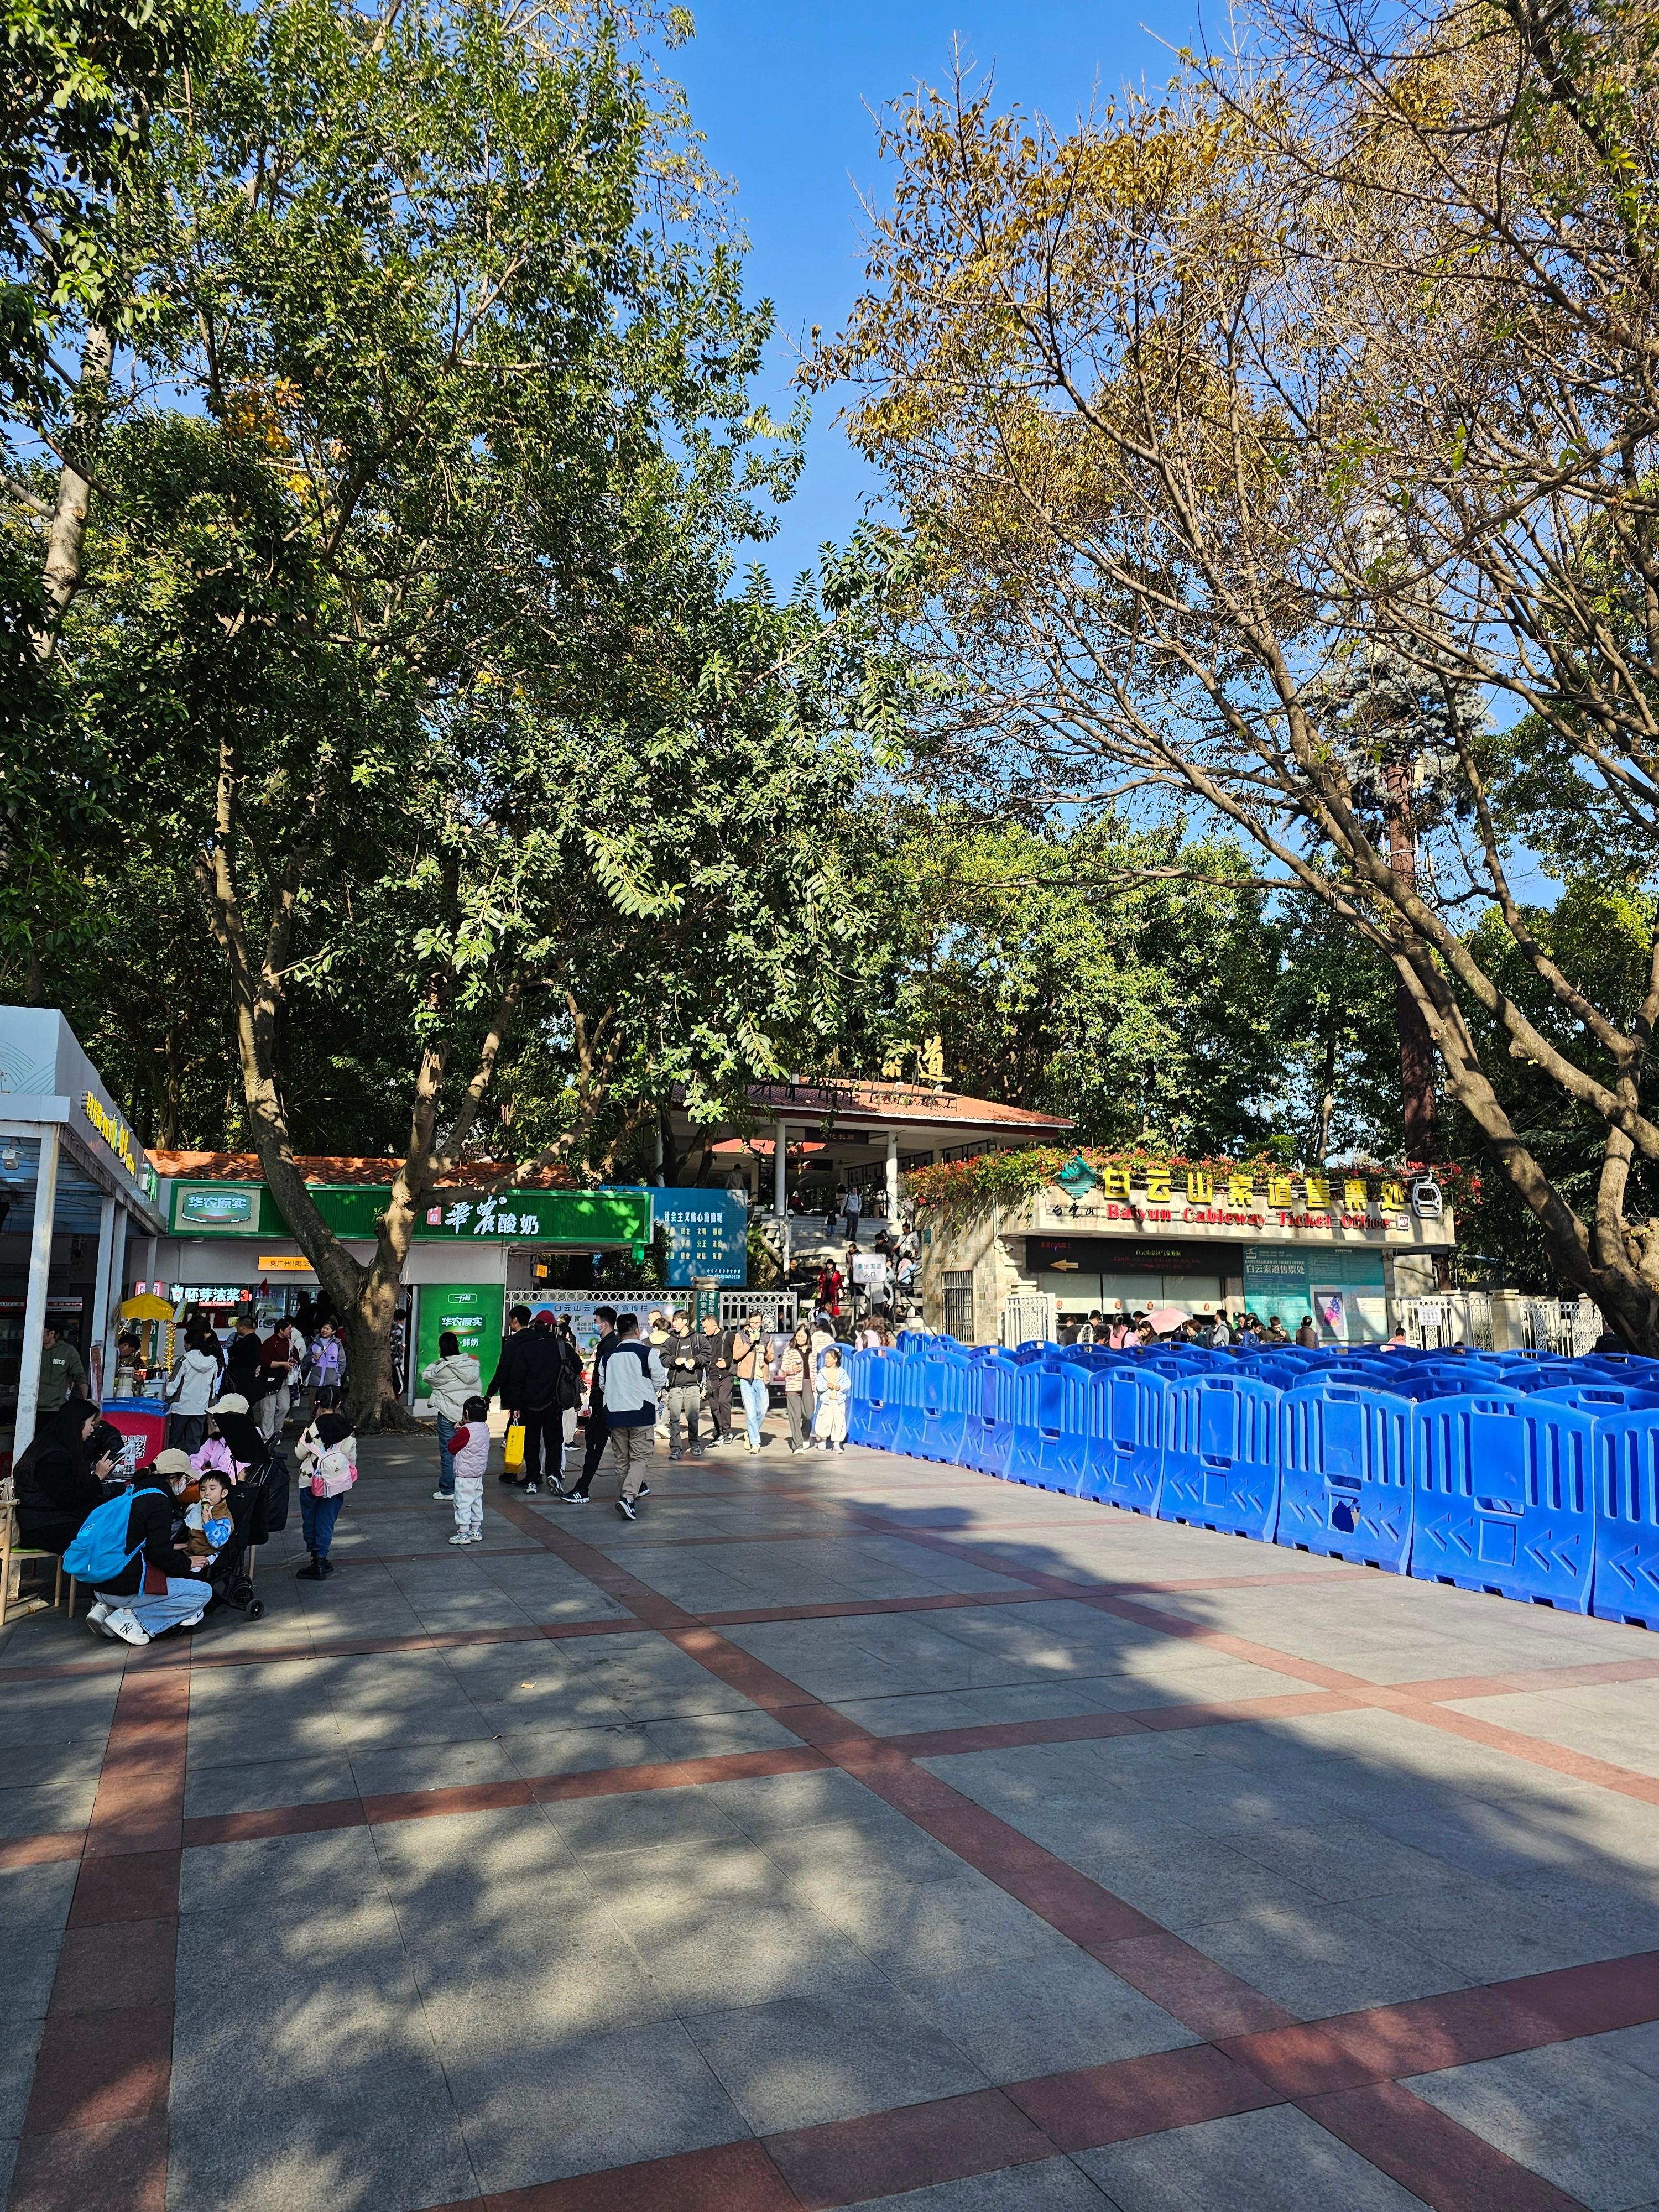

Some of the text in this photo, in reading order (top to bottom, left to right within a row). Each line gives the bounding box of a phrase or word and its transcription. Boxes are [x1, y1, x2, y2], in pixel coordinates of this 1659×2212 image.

[1103, 1167, 1405, 1211] 白云山索道售票处
[188, 1197, 247, 1209] 华农原实
[664, 1211, 723, 1223] 社会主义核心价值观
[1107, 1203, 1391, 1230] Baiyun Cableway Ticket Office
[498, 1213, 539, 1235] 酸奶
[1246, 1264, 1305, 1274] 白云索道售票处
[441, 1317, 483, 1327] 华农原实
